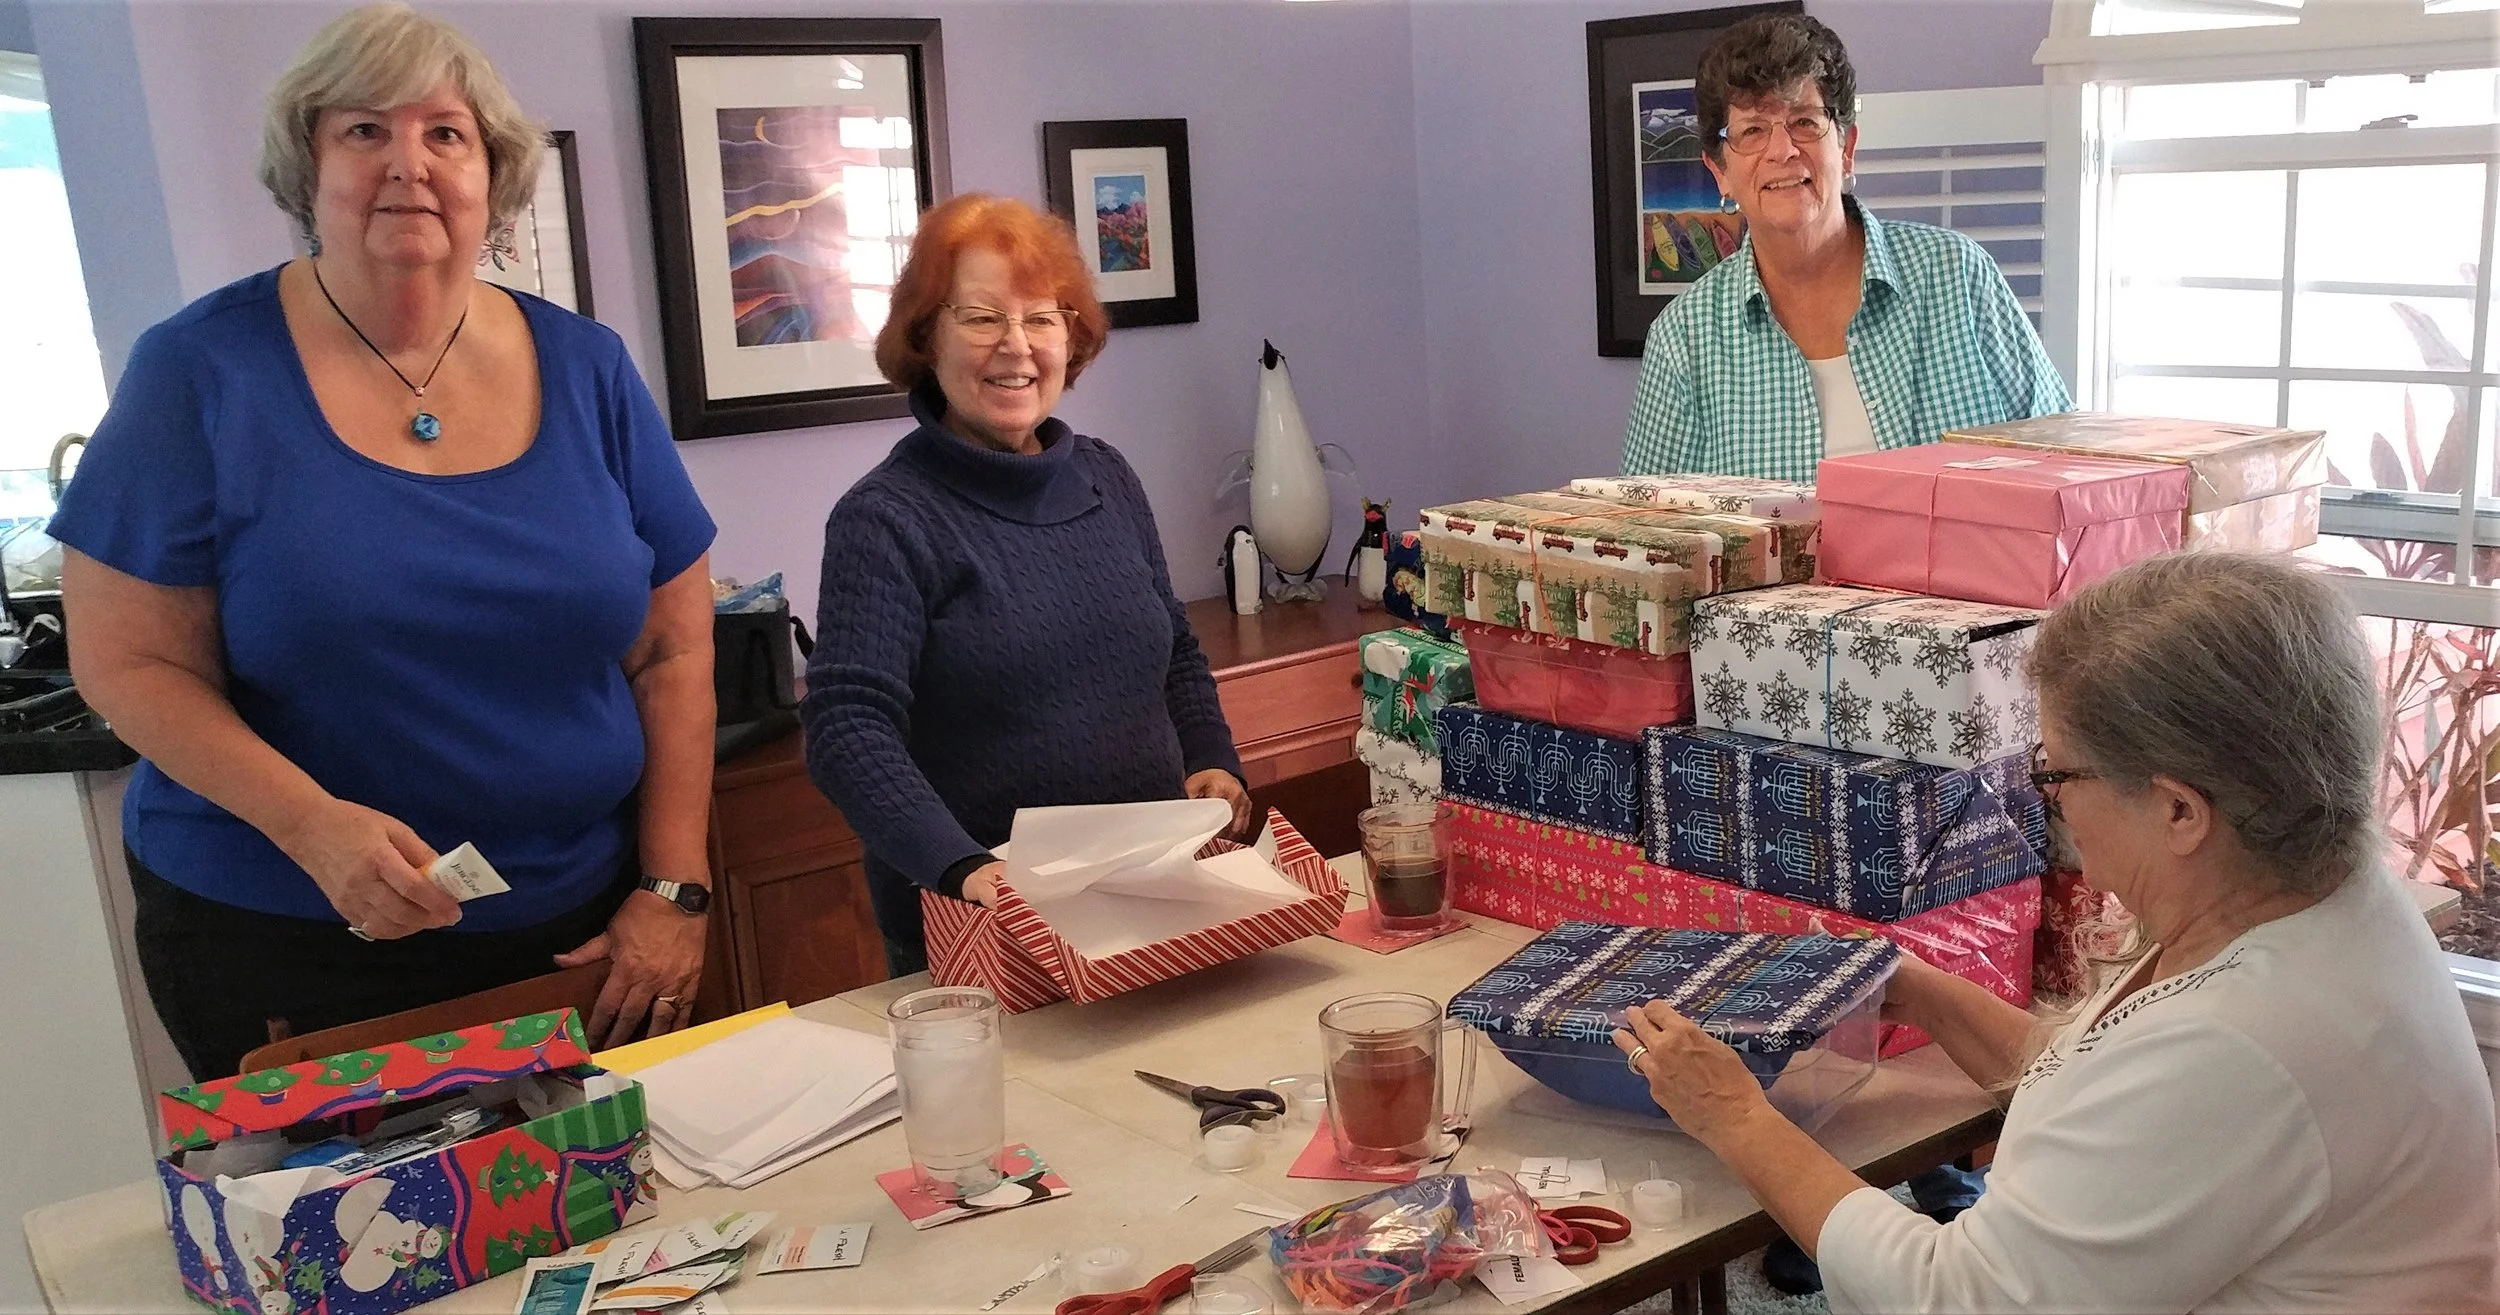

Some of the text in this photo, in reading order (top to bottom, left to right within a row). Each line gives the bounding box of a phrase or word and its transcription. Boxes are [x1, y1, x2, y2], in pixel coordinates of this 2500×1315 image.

[1721, 752, 1730, 803] HANUKKAH
[1815, 766, 1823, 821] HANUKKAH
[1924, 778, 1932, 833] HANUKKAH
[1725, 815, 1734, 866] HANUKKAH
[1816, 833, 1826, 887] HANUKKAH
[1937, 854, 1974, 872] HANUKKAH
[1982, 838, 2020, 858] HANUKKAH
[616, 1251, 636, 1276] FRESH
[832, 1237, 848, 1261] FRESH
